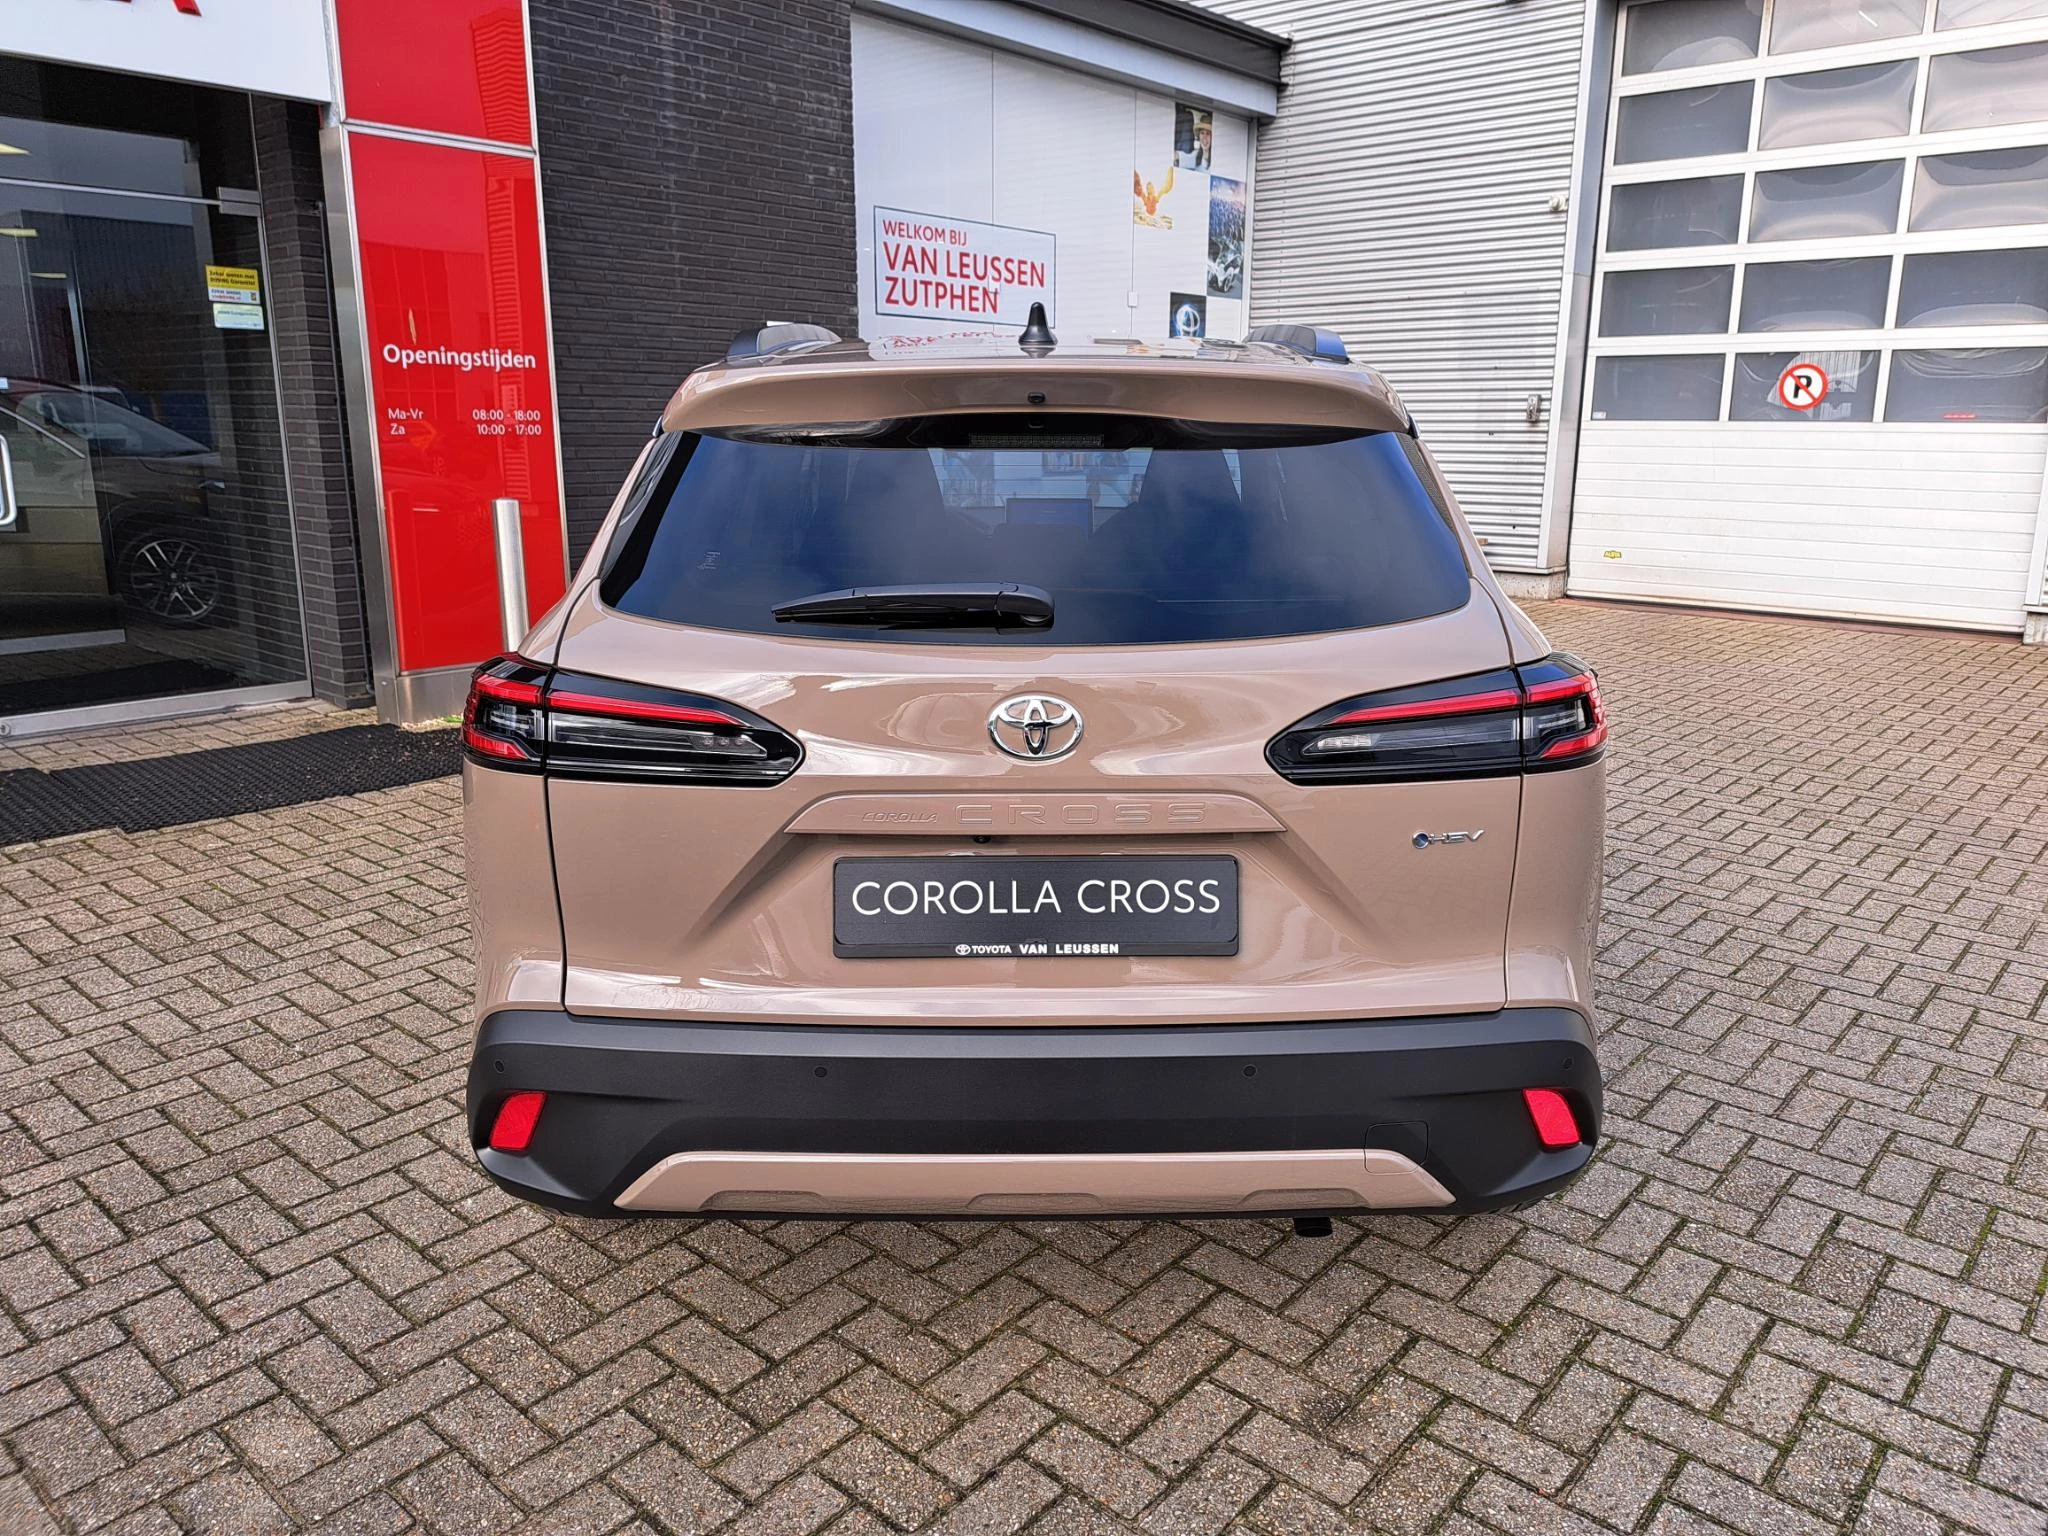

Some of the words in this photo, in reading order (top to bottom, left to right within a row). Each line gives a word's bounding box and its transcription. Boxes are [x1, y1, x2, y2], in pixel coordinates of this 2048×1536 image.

[882, 219, 946, 243] WELKOM
[949, 230, 968, 247] BIJ
[883, 241, 938, 276] VAN
[946, 249, 1046, 289] LEUSSEN
[885, 276, 1000, 315] ZUTPHEN
[383, 343, 537, 372] Openingstijden
[1793, 375, 1812, 399] P
[387, 408, 424, 420] Ma-Vr
[472, 409, 504, 421] 08:00
[514, 409, 541, 421] 18:00
[390, 423, 406, 435] Za
[476, 424, 506, 435] 10:00
[515, 424, 542, 435] 17:00
[862, 811, 938, 824] COROLLA
[955, 802, 1207, 825] CROSS
[851, 880, 1062, 916] COROLLA
[1077, 879, 1221, 914] CROSS
[971, 945, 1012, 955] TOYOTA
[1019, 944, 1048, 955] VAN
[1055, 943, 1119, 955] LEUSSEN
